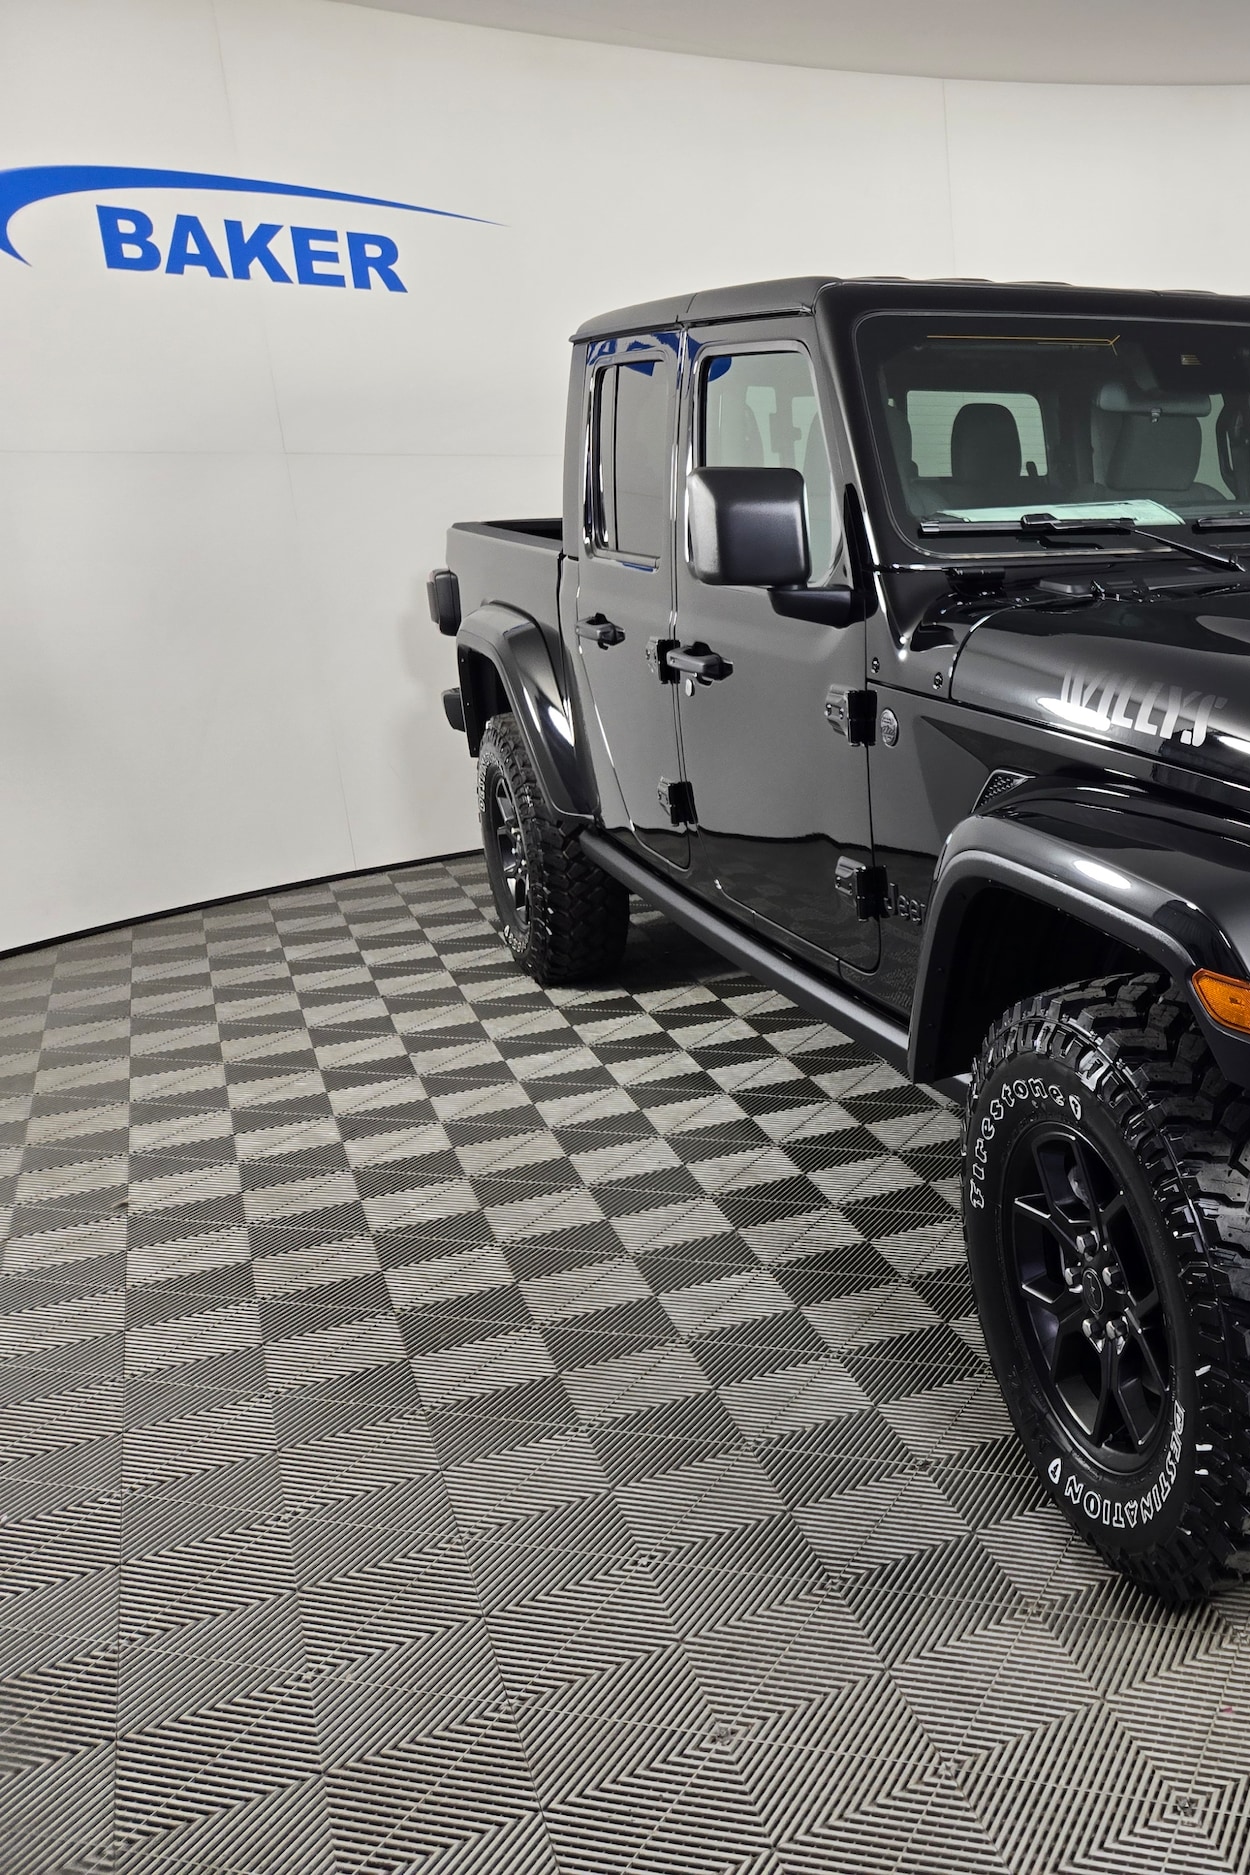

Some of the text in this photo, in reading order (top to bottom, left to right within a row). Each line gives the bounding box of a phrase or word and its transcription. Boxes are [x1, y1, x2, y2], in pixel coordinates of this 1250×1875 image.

[96, 204, 408, 293] BAKER
[1060, 664, 1228, 747] WILLYS
[969, 1077, 1065, 1209] Firestone
[1064, 1400, 1185, 1528] DESTINATION
